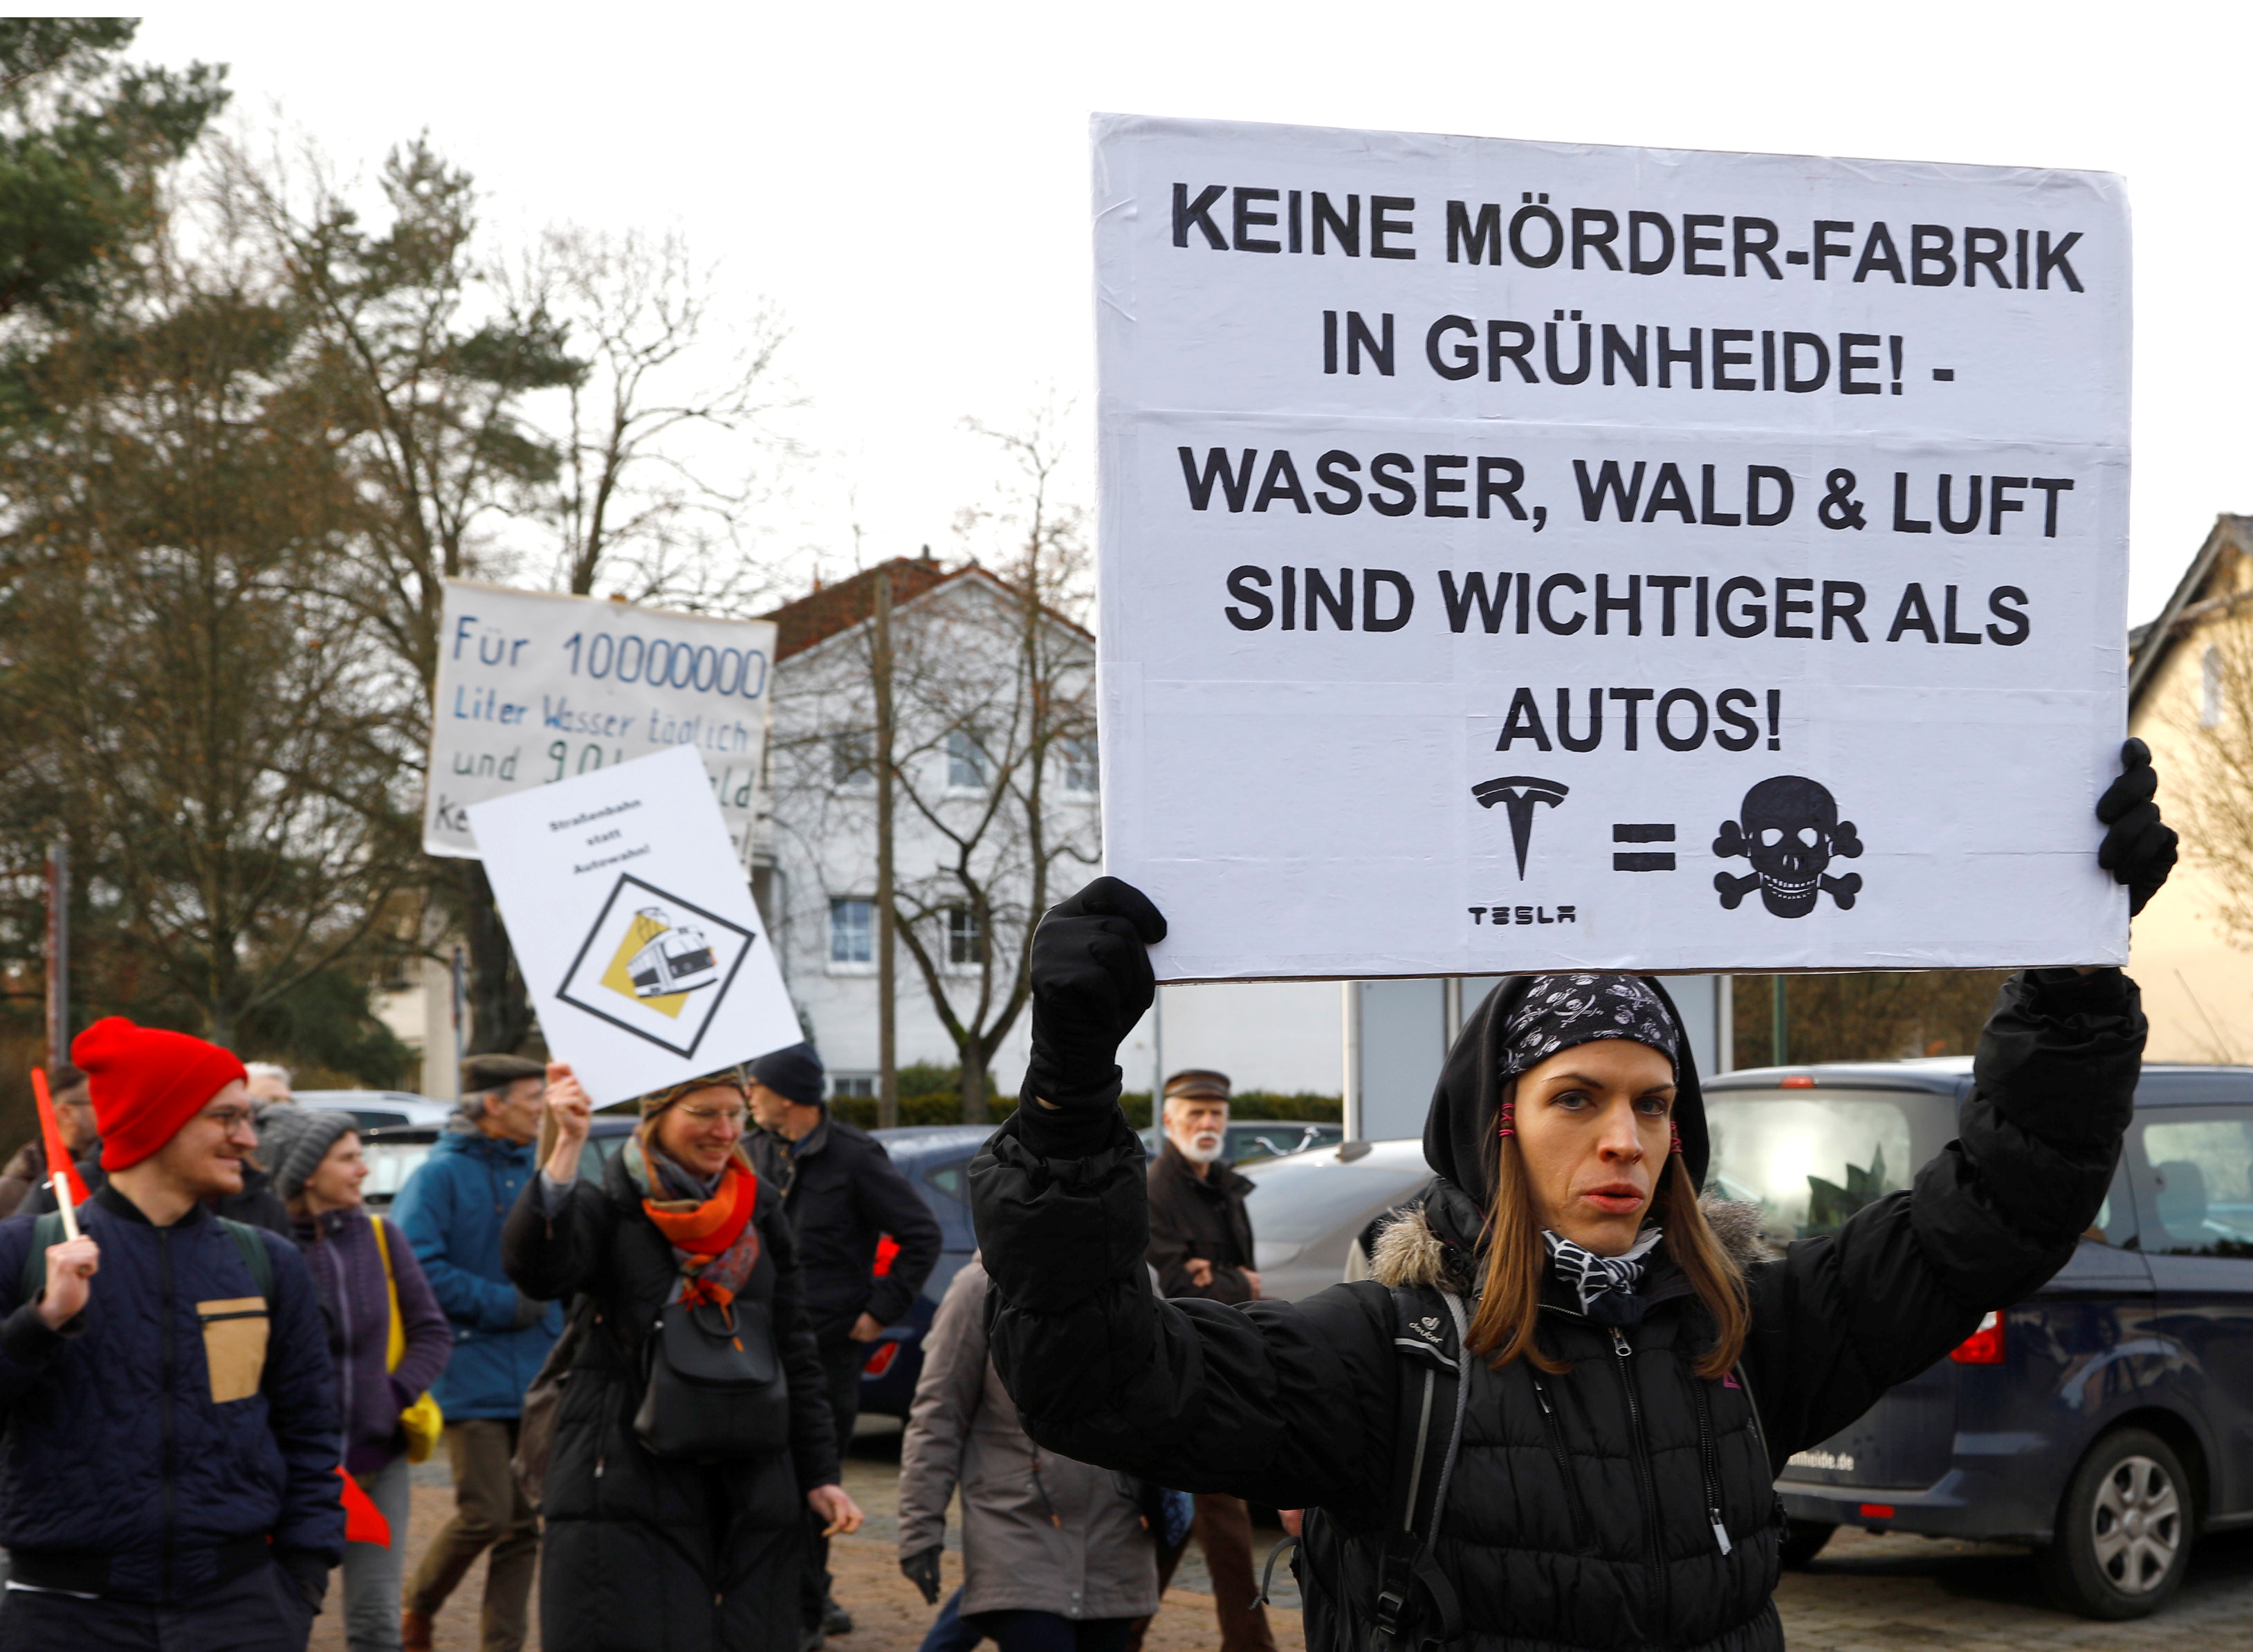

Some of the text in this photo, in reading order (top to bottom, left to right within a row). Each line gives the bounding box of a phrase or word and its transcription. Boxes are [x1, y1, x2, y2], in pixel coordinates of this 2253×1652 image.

[1173, 182, 2085, 293] KEINE MÖRDER-FABRIK
[1323, 310, 1395, 377] IN
[1426, 309, 1904, 396] GRÜNHEIDE!
[1177, 446, 2075, 538] WASSER, WALD & LUFT
[1224, 565, 2030, 647] SIND WICHTIGER ALS
[453, 615, 767, 699] Für 10000000
[453, 683, 530, 726] Liter
[1495, 687, 1781, 752] AUTOS!
[454, 745, 522, 782] und
[549, 799, 642, 832] Straßenbahn
[586, 828, 623, 847] statt
[1468, 905, 1576, 926] TESLA
[1408, 1322, 1444, 1343] deuter
